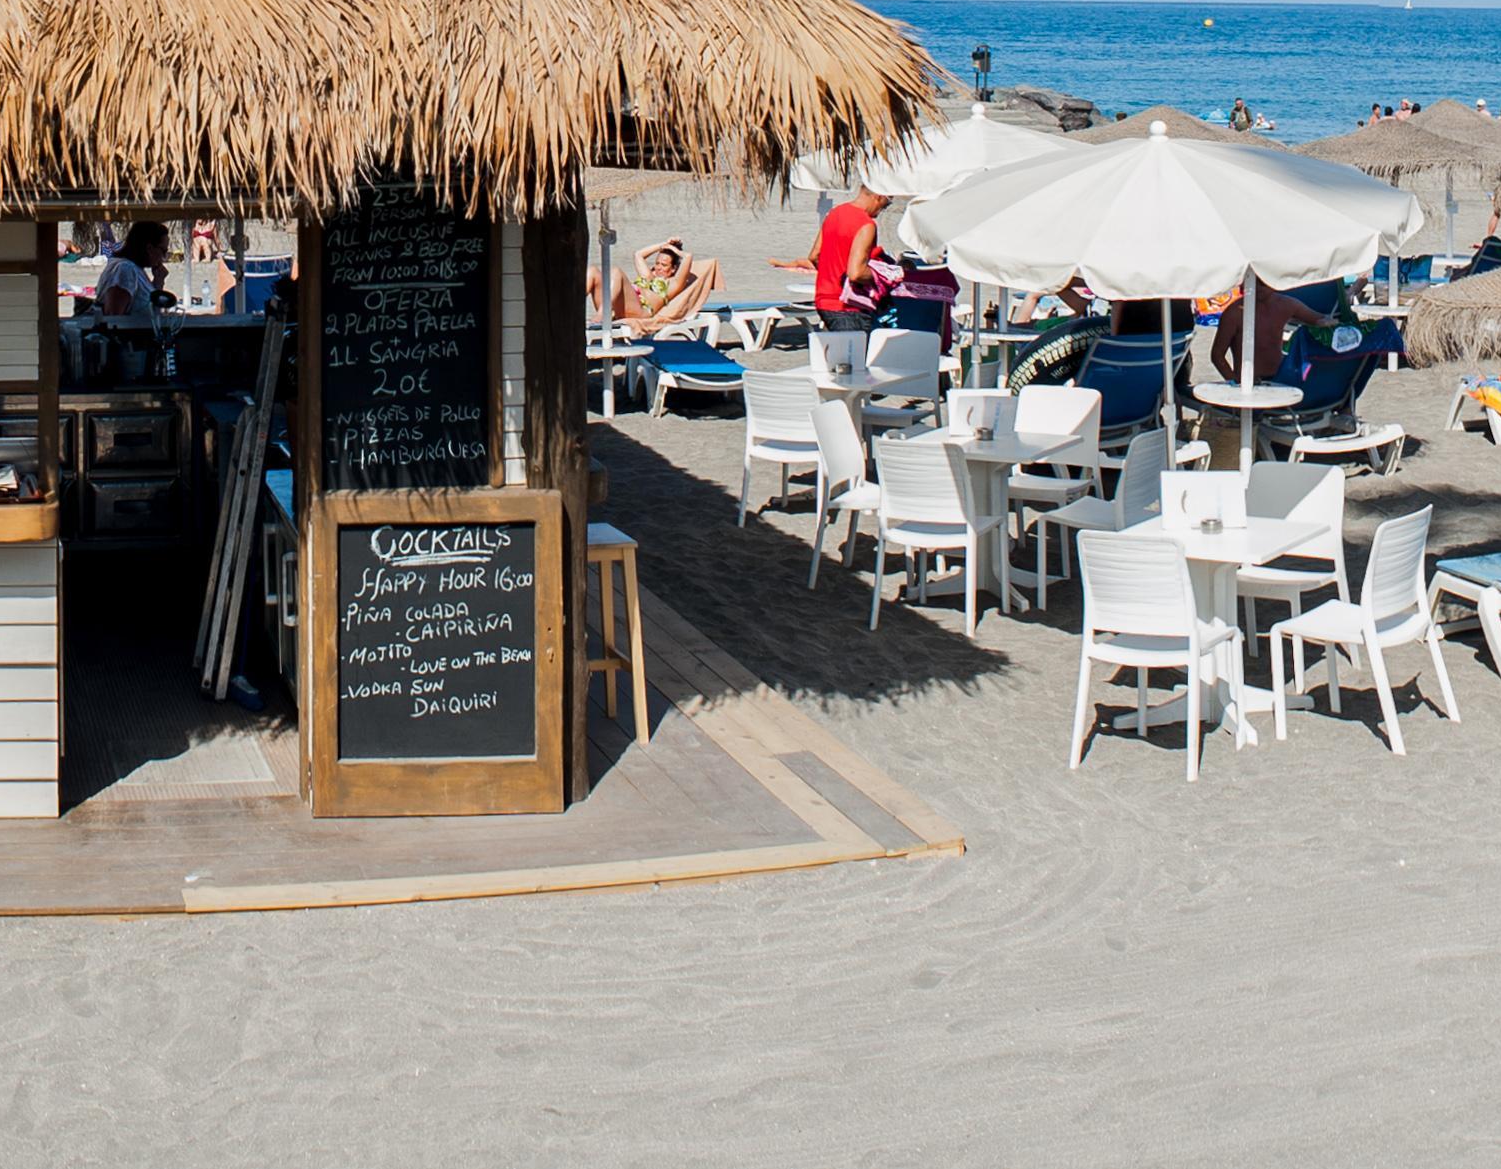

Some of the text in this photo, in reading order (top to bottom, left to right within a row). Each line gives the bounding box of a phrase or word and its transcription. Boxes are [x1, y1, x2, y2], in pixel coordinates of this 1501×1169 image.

[370, 207, 426, 225] PERSON
[327, 226, 361, 248] ALL
[418, 240, 449, 258] BED
[450, 237, 485, 258] FREE
[380, 263, 418, 282] 10:00
[364, 287, 454, 313] OFERTA
[324, 314, 340, 335] 2
[414, 309, 477, 338] PAELLA
[415, 406, 432, 422] DE
[370, 525, 512, 561] COCKTAILS
[354, 566, 534, 601] HAPPY HOUR 16:00
[410, 655, 447, 675] LOVE
[451, 656, 470, 669] ON
[473, 650, 497, 666] THE
[410, 679, 445, 696] SUN
